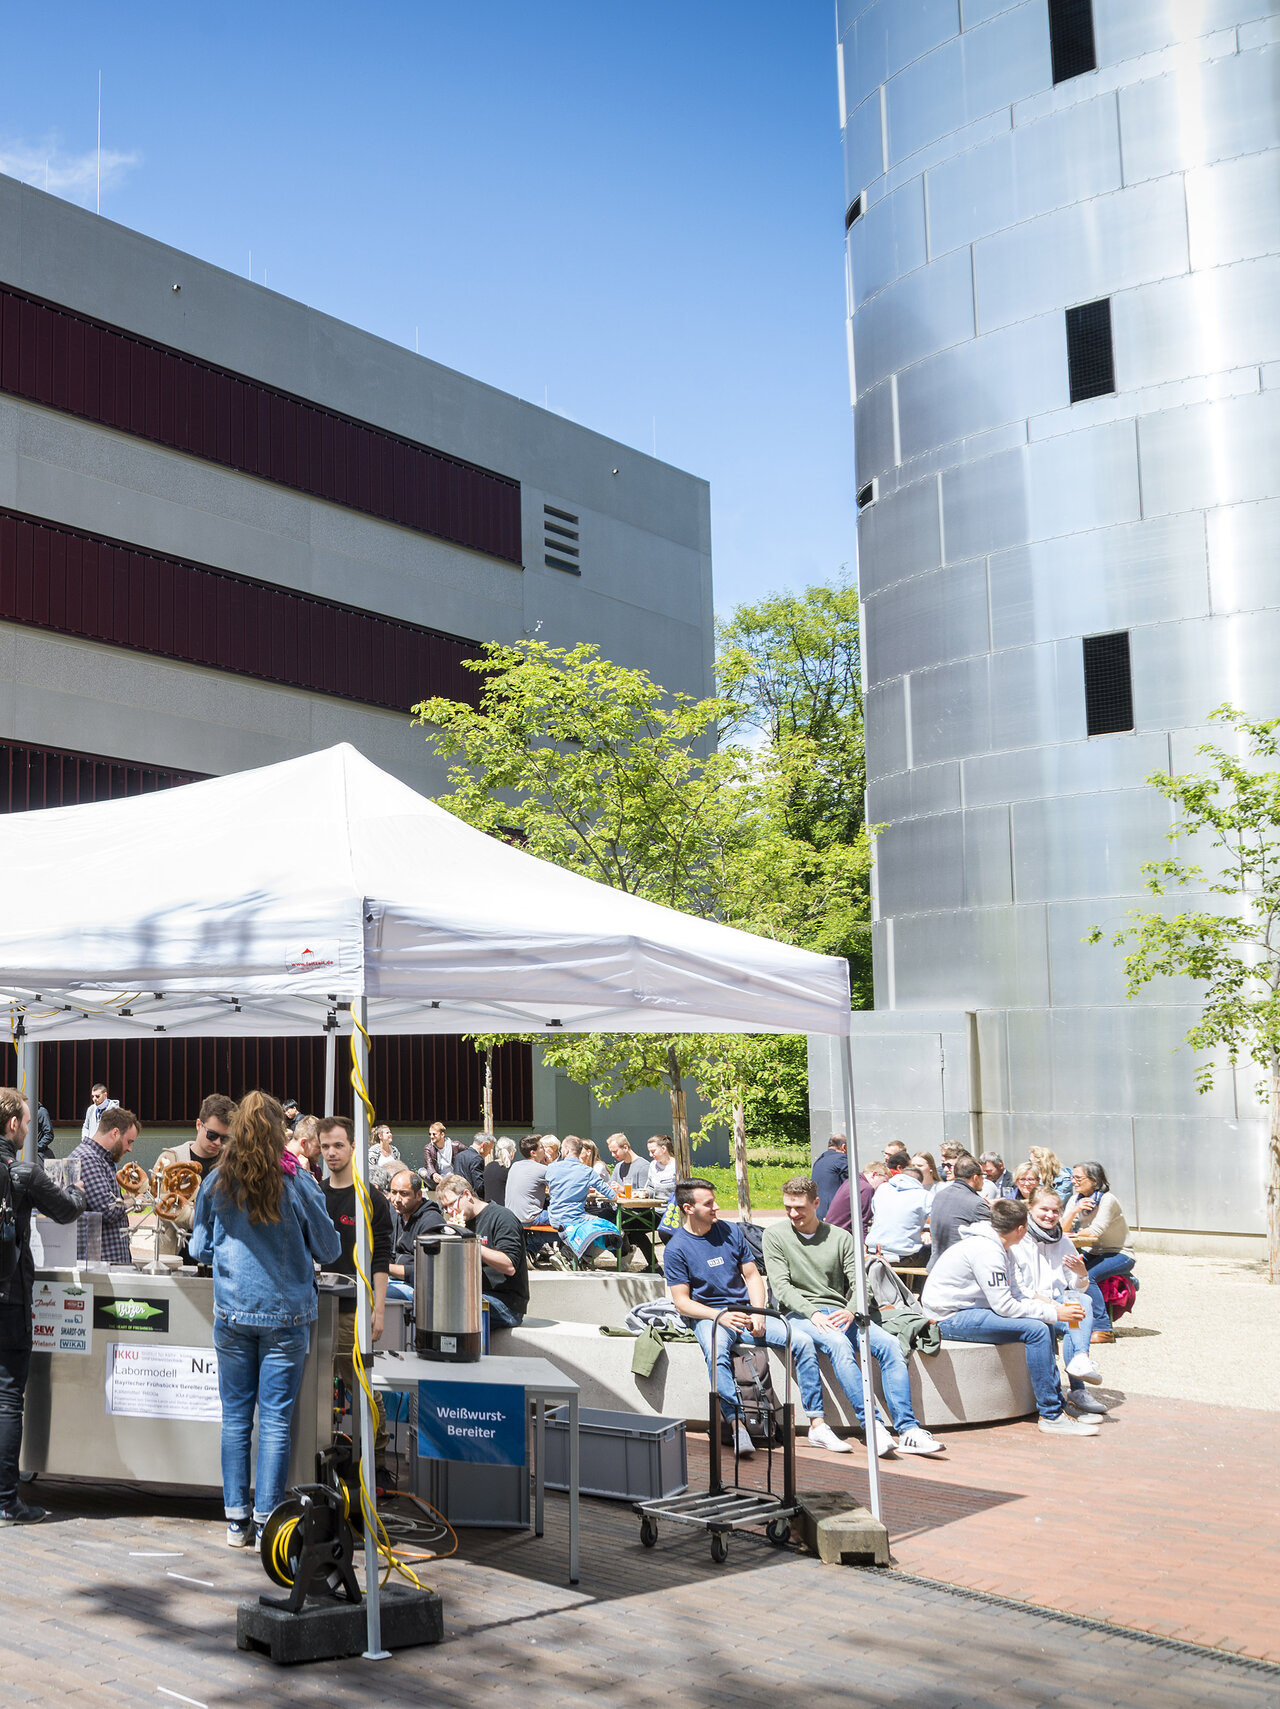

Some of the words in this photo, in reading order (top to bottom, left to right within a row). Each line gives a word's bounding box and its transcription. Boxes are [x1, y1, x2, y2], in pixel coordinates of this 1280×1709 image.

[33, 1325, 55, 1333] SEW
[114, 1349, 139, 1360] IKKU
[114, 1366, 177, 1378] Labormodell
[191, 1358, 216, 1374] Nr.
[114, 1380, 145, 1388] Bayrischer
[436, 1406, 506, 1422] Weißwurst-
[447, 1424, 496, 1439] Bereiter
